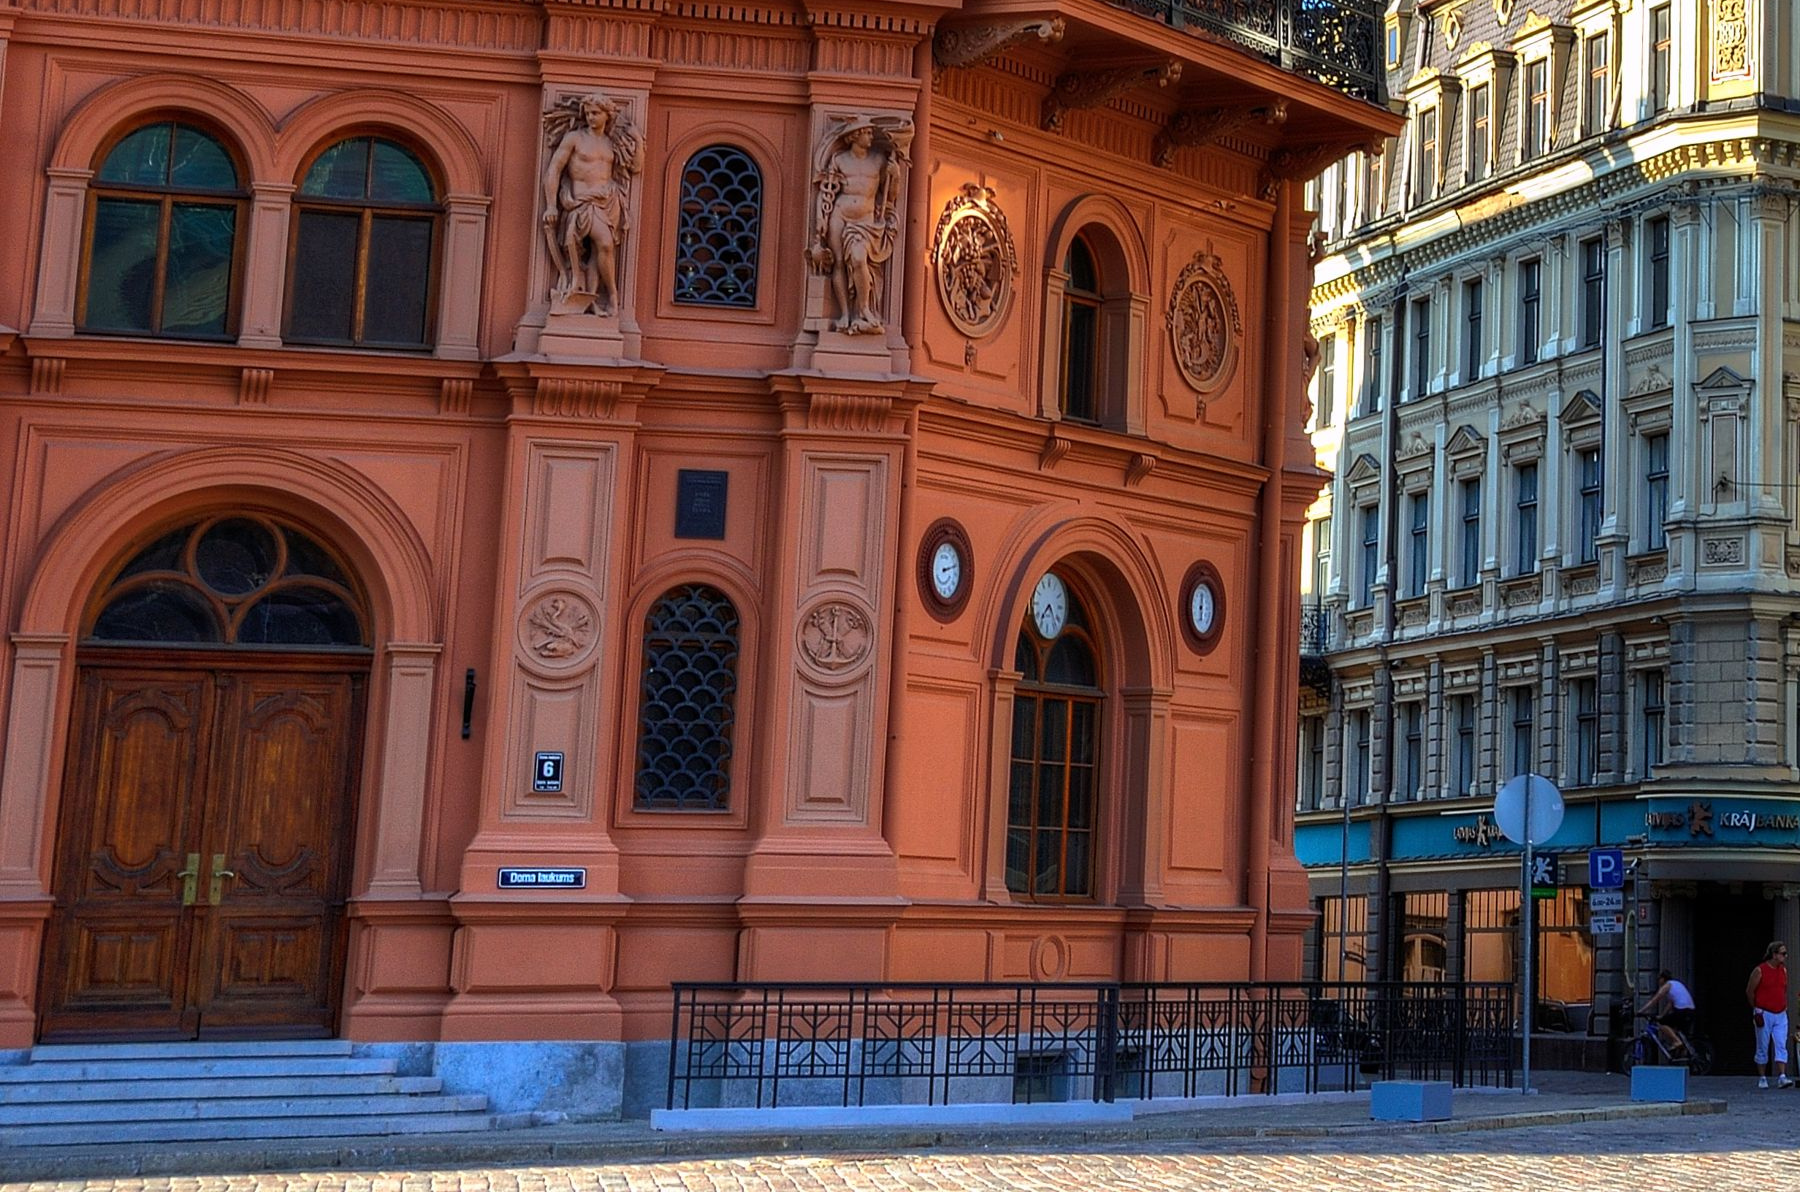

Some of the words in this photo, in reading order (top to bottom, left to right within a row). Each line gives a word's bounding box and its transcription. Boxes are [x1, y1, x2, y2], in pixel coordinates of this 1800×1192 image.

[543, 761, 554, 777] 6
[1720, 810, 1800, 832] KRĀJBANKA
[510, 872, 536, 883] Doma
[538, 872, 574, 883] laukums
[1597, 855, 1615, 883] P
